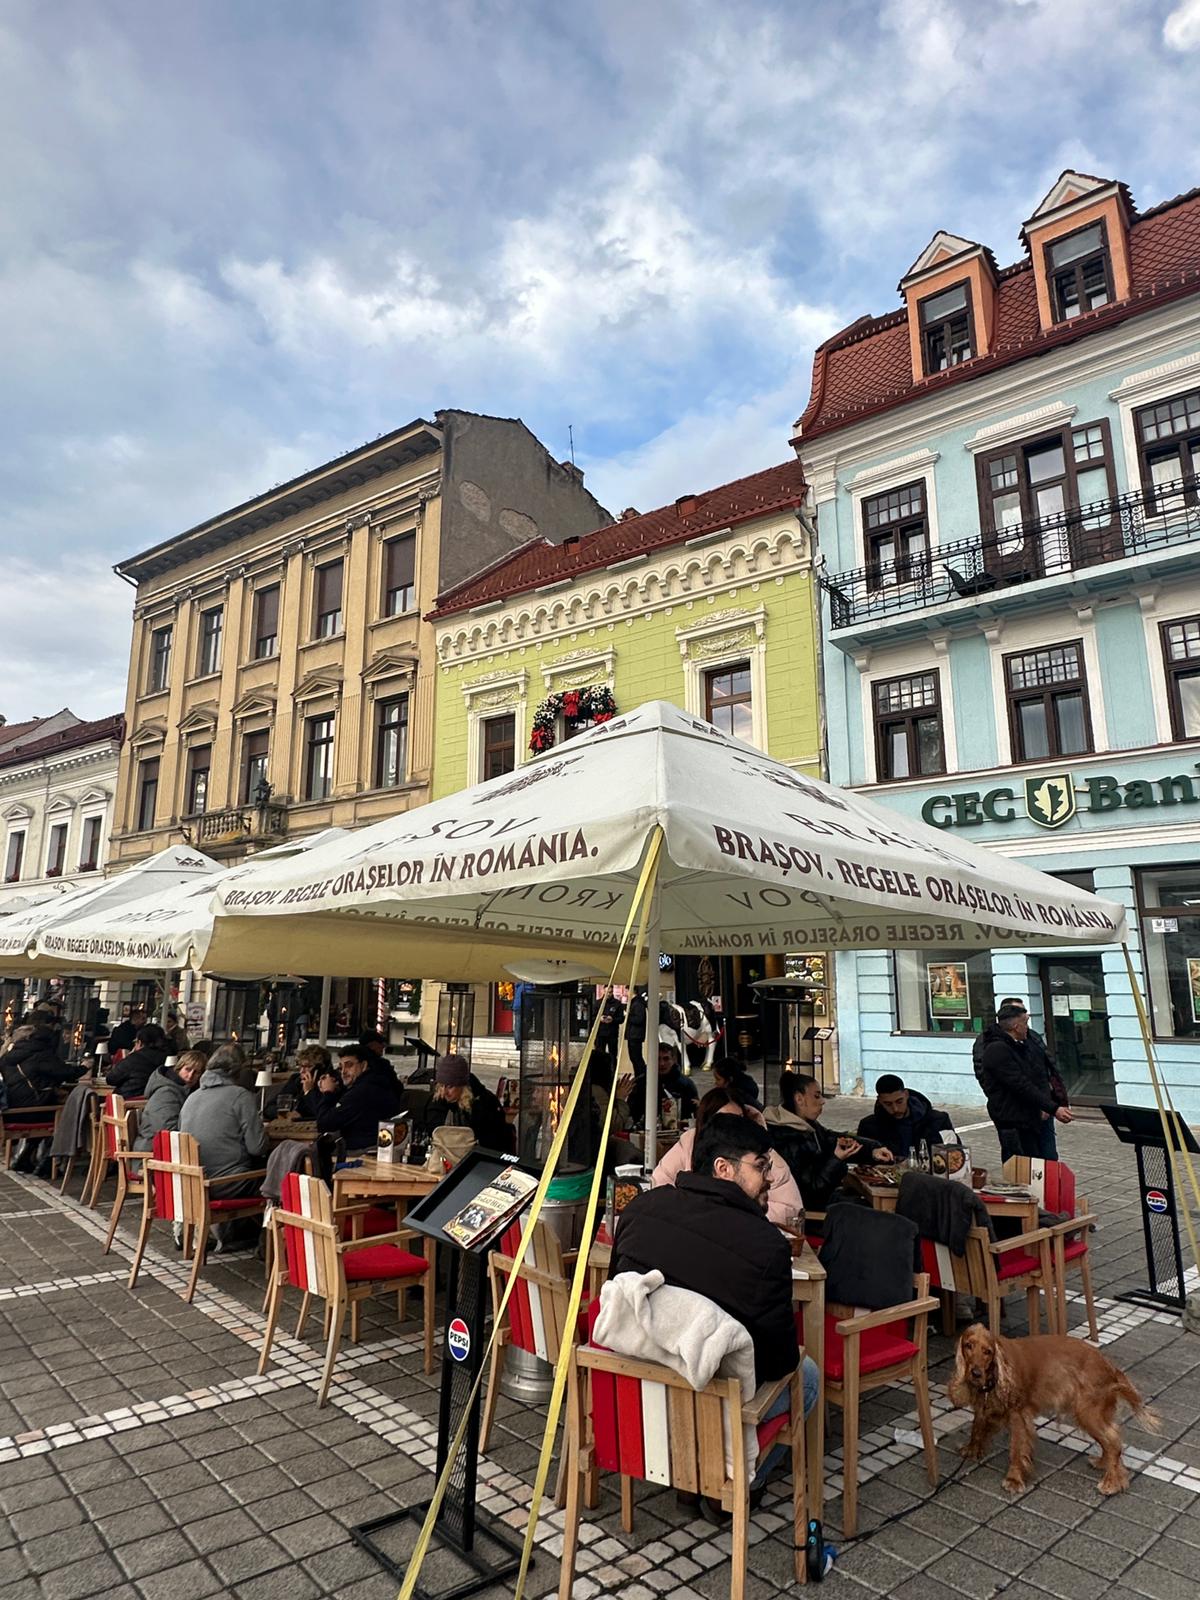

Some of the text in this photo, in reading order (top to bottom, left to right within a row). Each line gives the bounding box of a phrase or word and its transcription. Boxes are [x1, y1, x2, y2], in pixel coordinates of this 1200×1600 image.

[921, 762, 1200, 828] CEC Ban
[278, 879, 333, 904] REGELE
[332, 860, 423, 896] ORAȘELOR
[429, 852, 456, 882] ÎN
[460, 827, 598, 879] ROMÂNIA.
[712, 825, 1117, 930] BRAȘOV. REGELE ORAȘELOR ÎN ROMÂNIA.
[500, 1153, 520, 1163] PEPSI
[450, 1332, 468, 1348] PEPSI
